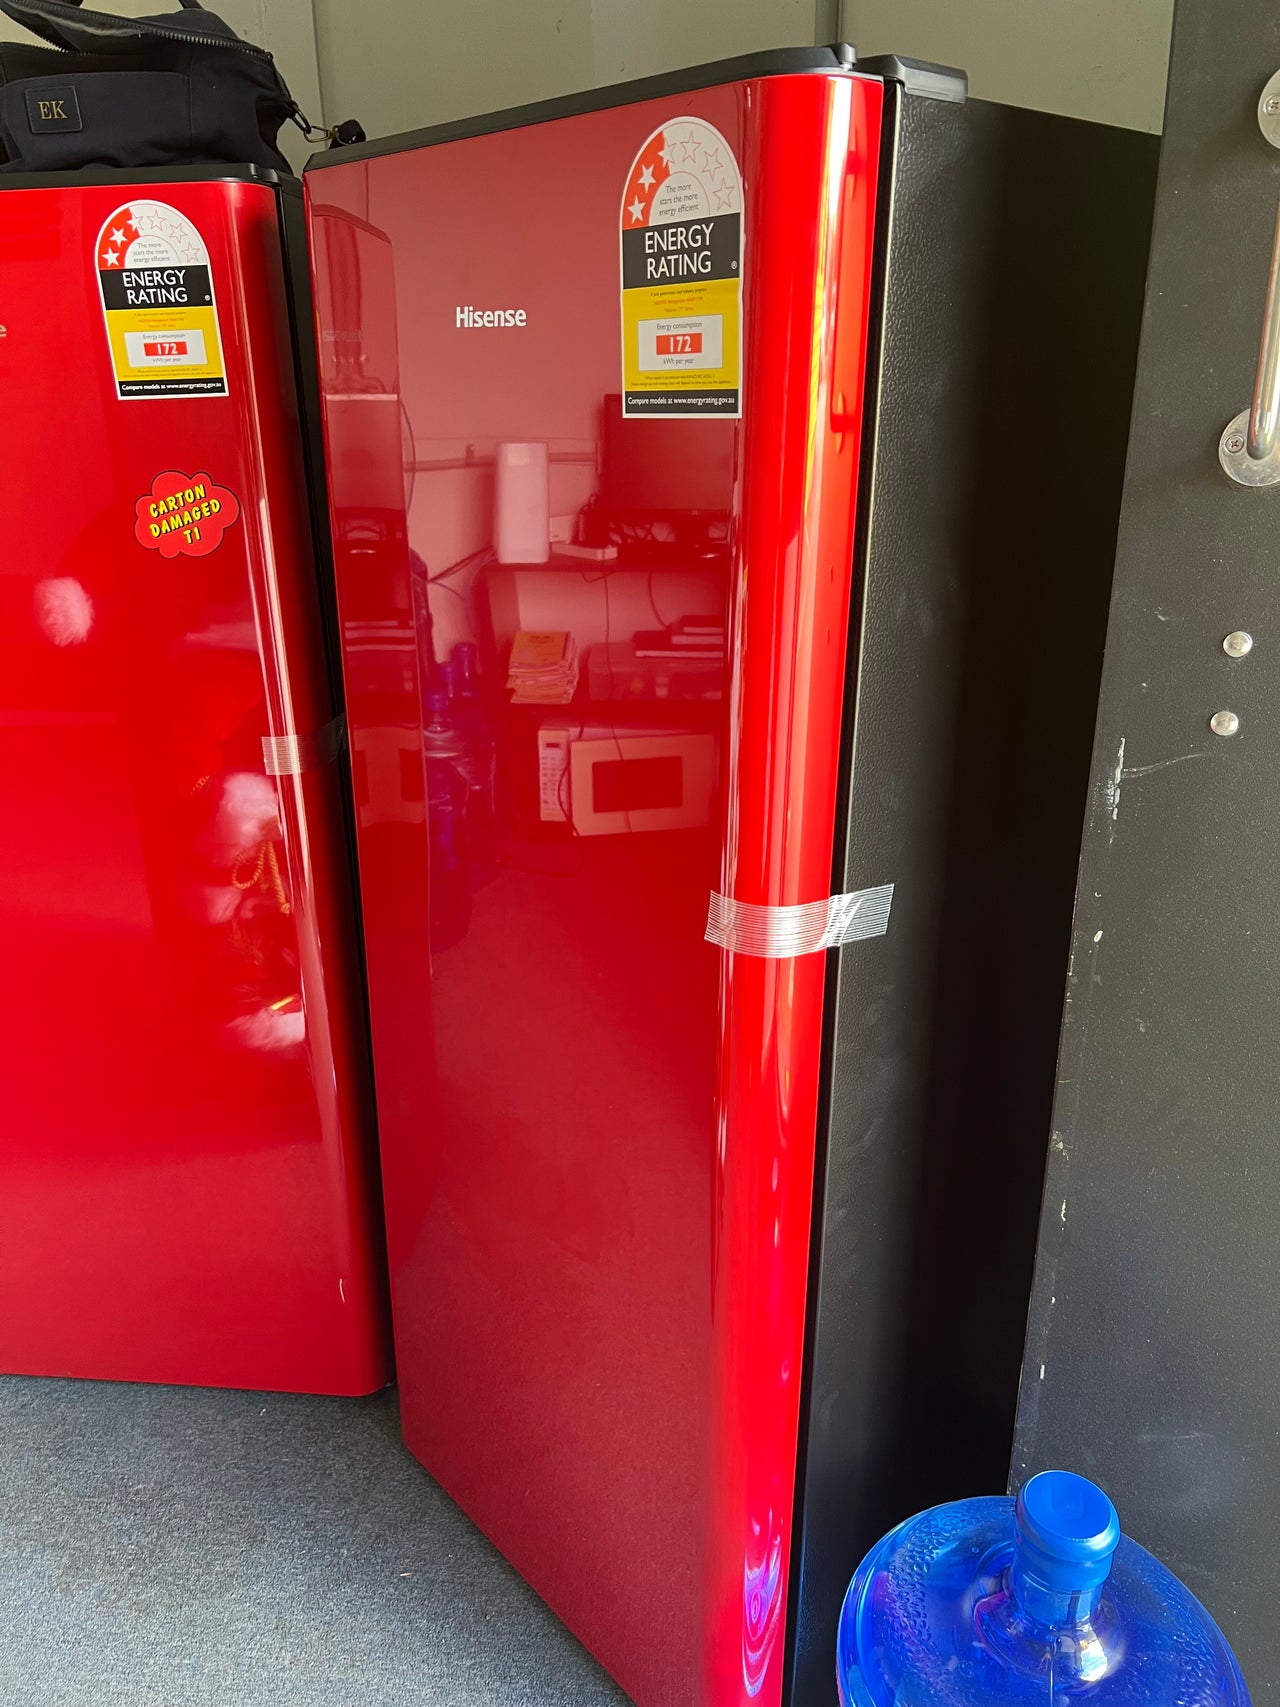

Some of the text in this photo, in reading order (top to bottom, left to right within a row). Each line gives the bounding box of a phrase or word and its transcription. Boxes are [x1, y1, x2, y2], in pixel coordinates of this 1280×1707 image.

[38, 100, 68, 120] EK
[665, 184, 692, 194] The more
[673, 195, 682, 203] the
[683, 193, 699, 202] more
[659, 203, 699, 217] energy efficient
[645, 222, 715, 254] ENERGY
[647, 251, 712, 279] RATING
[122, 269, 186, 287] ENERGY
[126, 287, 188, 305] RATING
[456, 306, 527, 328] Hisense
[656, 321, 702, 331] Energy consumption
[157, 343, 178, 355] 172
[669, 335, 692, 353] 172
[663, 357, 695, 366] kWh per year
[121, 384, 143, 392] Compare
[166, 382, 222, 390] www.energyrating.gov.au
[628, 396, 649, 406] Compare
[649, 396, 667, 405] models
[673, 396, 735, 406] www.energyrating.gov.au
[149, 483, 206, 518] CARTON
[149, 498, 221, 538] DAMAGED
[183, 526, 201, 544] T1
